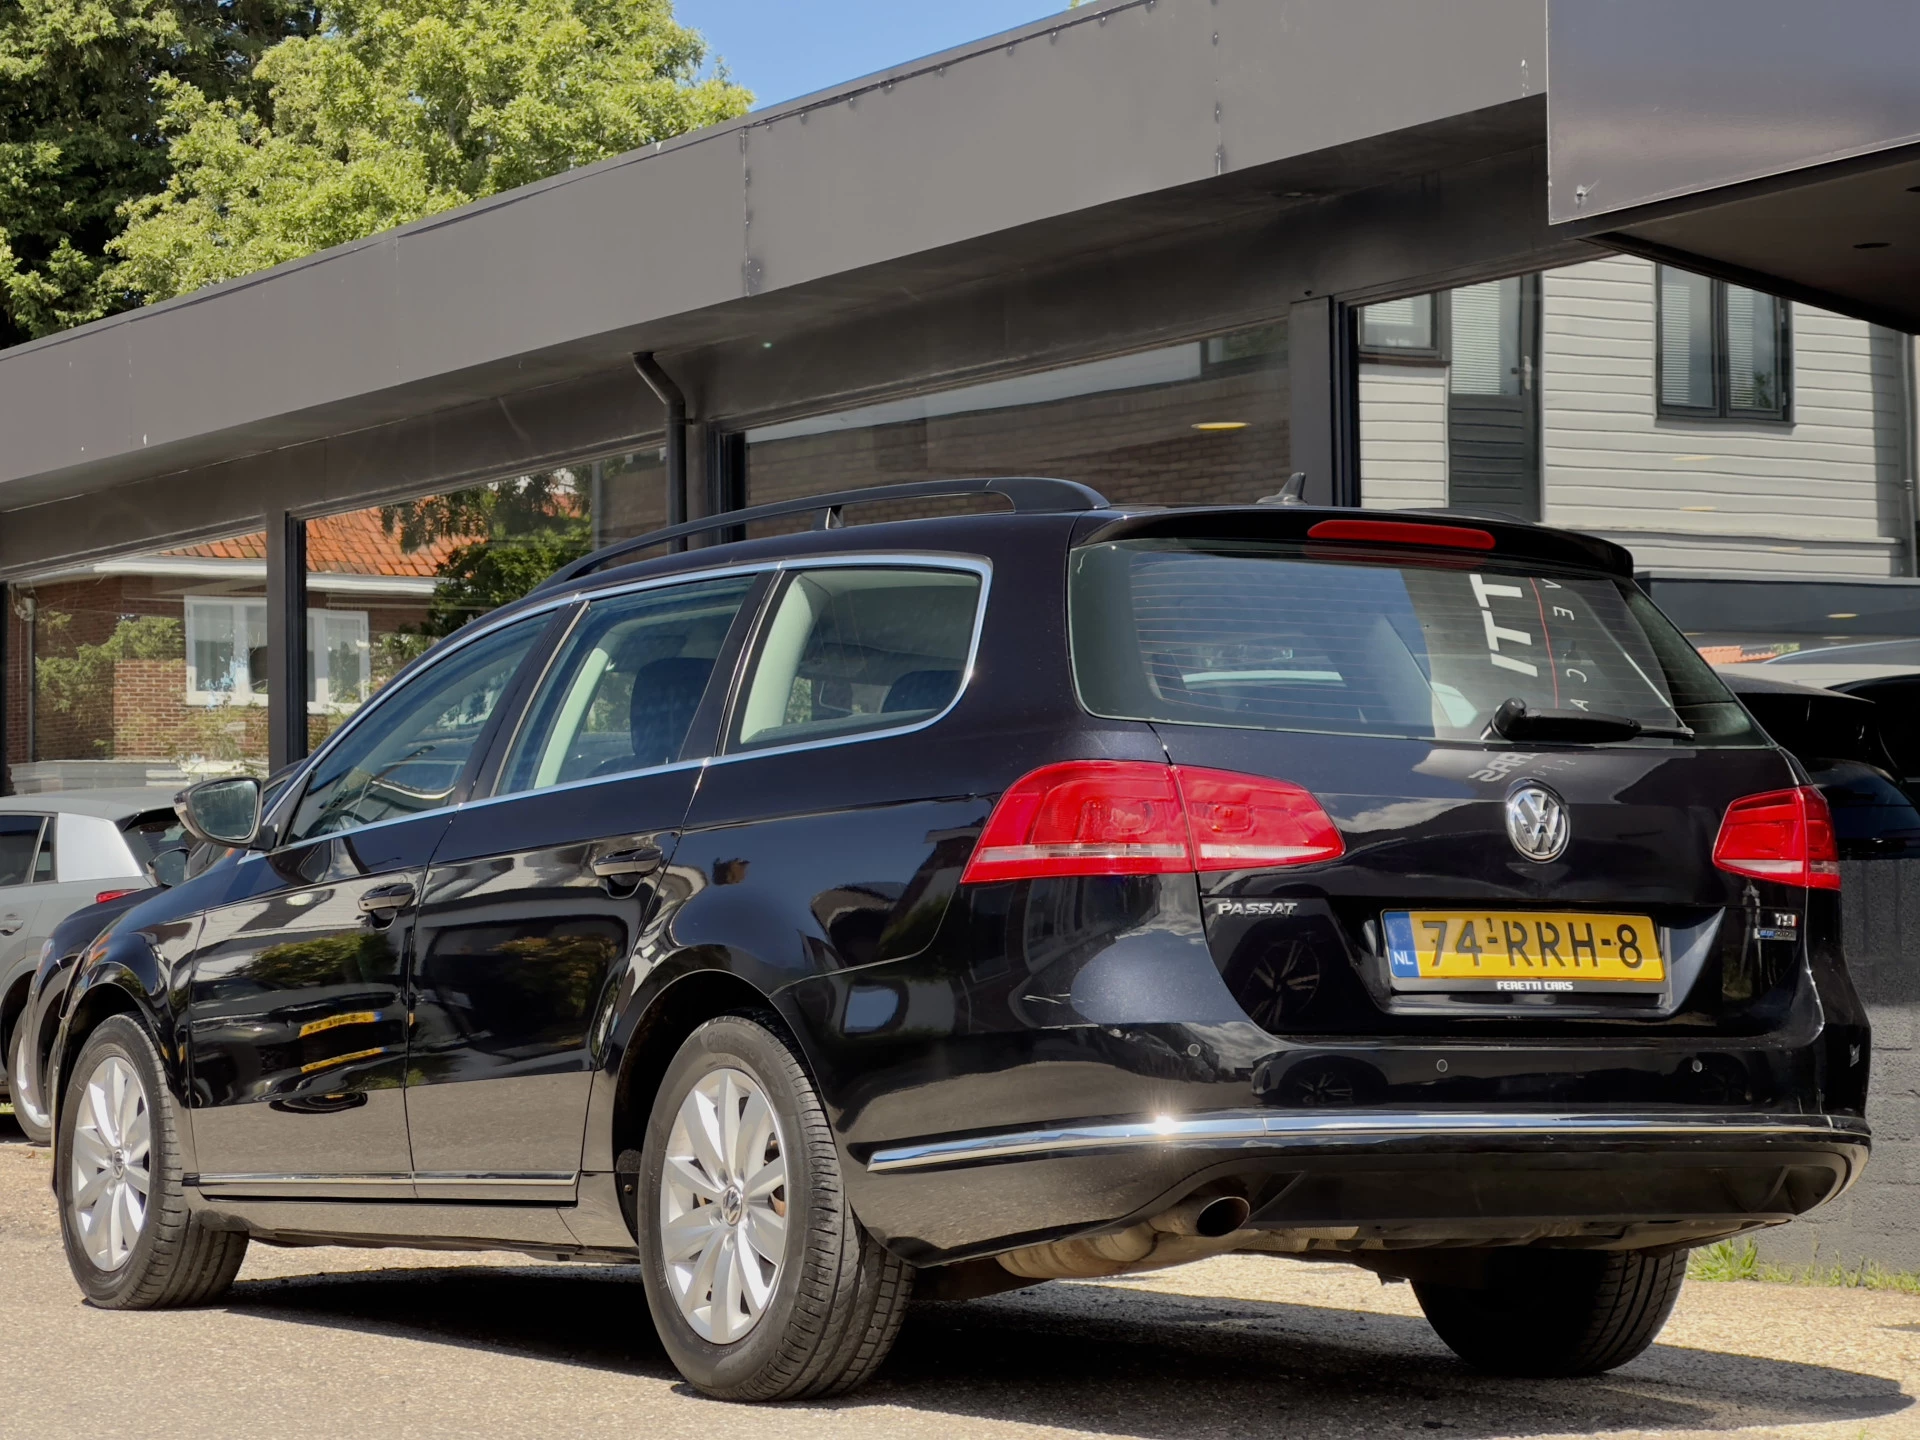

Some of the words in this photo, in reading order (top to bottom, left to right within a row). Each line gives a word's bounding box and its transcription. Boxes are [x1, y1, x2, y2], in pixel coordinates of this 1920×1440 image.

[1217, 902, 1298, 915] PASSAT
[1394, 951, 1414, 966] NL
[1497, 981, 1542, 991] FERETTI
[1544, 981, 1574, 991] CARS
